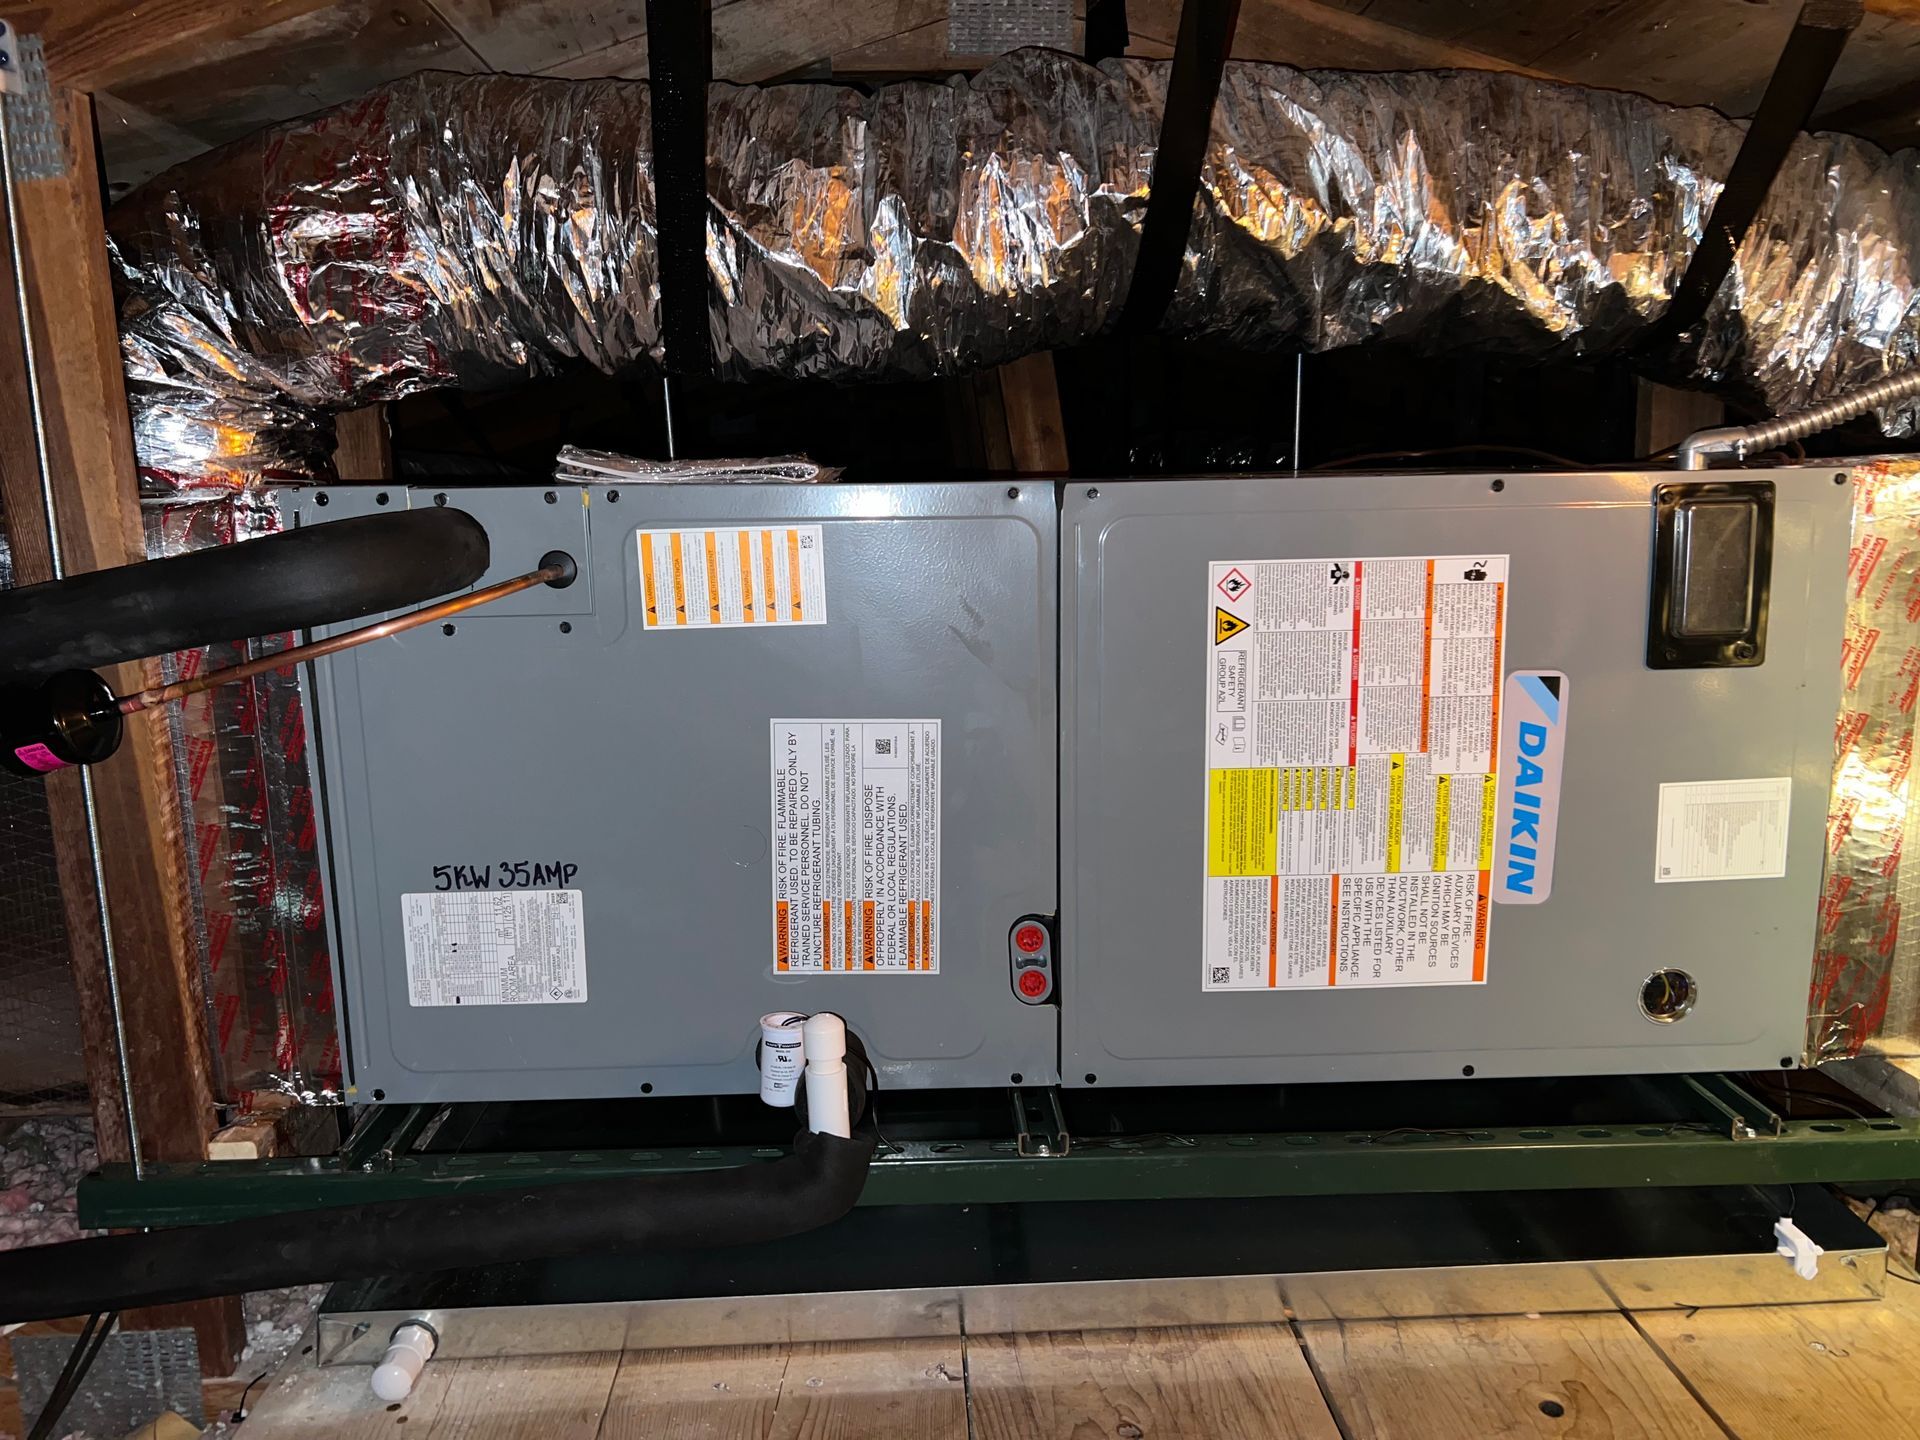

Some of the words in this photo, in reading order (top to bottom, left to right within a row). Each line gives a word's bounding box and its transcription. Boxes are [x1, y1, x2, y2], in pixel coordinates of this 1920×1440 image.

[645, 573, 653, 602] WARNING
[674, 558, 682, 601] ADVERTENCIA
[708, 549, 717, 601] AVERTISSEMENT
[1227, 665, 1235, 697] SAFETY
[1236, 651, 1245, 709] REFRIGERANT
[788, 731, 796, 745] BY
[788, 747, 797, 776] ONLY
[799, 770, 808, 792] NOT
[776, 768, 786, 829] FLAMMABLE
[788, 778, 797, 829] REPAIRED
[800, 794, 809, 809] DO
[864, 784, 872, 828] DISPOSE
[876, 786, 884, 812] WITH
[1440, 784, 1448, 817] ATTENTION
[1505, 721, 1548, 895] DAIKIN
[812, 797, 820, 837] TUBING.
[887, 792, 896, 866] REGULATIONS.
[899, 801, 907, 831] USED.
[1485, 814, 1493, 846] INSTALLER
[777, 831, 786, 857] FIRE.
[789, 831, 798, 845] BE
[789, 847, 798, 862] TO
[800, 811, 809, 876] PERSONNEL.
[864, 830, 872, 856] FIRE.
[875, 814, 884, 885] ACCORDANCE
[433, 864, 491, 891] 5KW
[498, 860, 578, 889] 35AMP
[778, 859, 786, 873] OF
[789, 864, 798, 894] USED.
[812, 839, 821, 910] REFRIGERANT
[864, 858, 872, 873] OF
[898, 833, 907, 905] REFRIGERANT
[778, 875, 787, 898] RISK
[801, 878, 810, 922] SERVICE
[864, 875, 872, 898] RISK
[875, 887, 884, 897] IN
[887, 868, 895, 902] LOCAL
[1341, 877, 1351, 898] SEE
[1352, 877, 1362, 922] SPECIFIC
[1364, 877, 1373, 897] USE
[1374, 877, 1385, 919] DEVICES
[1386, 876, 1396, 903] THAN
[1419, 875, 1429, 906] SHALL
[1430, 875, 1440, 918] IGNITION
[1441, 874, 1452, 908] WHICH
[1451, 874, 1463, 924] AUXILIARY
[1464, 874, 1475, 897] RISK
[887, 903, 895, 919] OR
[1363, 898, 1372, 925] WITH
[1395, 876, 1407, 936] DUCTWORK,
[1407, 876, 1418, 928] INSTALLED
[1418, 908, 1428, 929] NOT
[1464, 898, 1473, 913] OF
[778, 908, 787, 955] WARNING
[790, 896, 799, 966] REFRIGERANT
[864, 908, 872, 955] WARNING
[875, 899, 884, 965] OFPROPERLY
[898, 906, 907, 965] FLAMMABLE
[1339, 899, 1350, 974] INSTRUCTIONS.
[1362, 926, 1371, 946] THE
[1384, 904, 1395, 955] AUXILIARY
[1407, 930, 1416, 940] IN
[1440, 909, 1450, 931] MAY
[1462, 914, 1473, 937] FIRE
[1475, 903, 1486, 949] WARNING
[801, 923, 810, 966] TRAINED
[813, 912, 821, 966] PUNCTURE
[887, 921, 895, 965] FEDERAL
[1350, 923, 1361, 980] APPLIANCE.
[1373, 921, 1383, 955] LISTED
[1406, 942, 1415, 962] THE
[1418, 931, 1427, 944] BE
[1427, 919, 1438, 967] SOURCES
[1440, 933, 1449, 946] BE
[1449, 926, 1460, 968] DEVICES
[507, 954, 516, 976] AREA
[1372, 957, 1381, 978] FOR
[1394, 938, 1404, 972] OTHER
[499, 967, 509, 1002] MINIMUM
[508, 977, 517, 1001] ROOM
